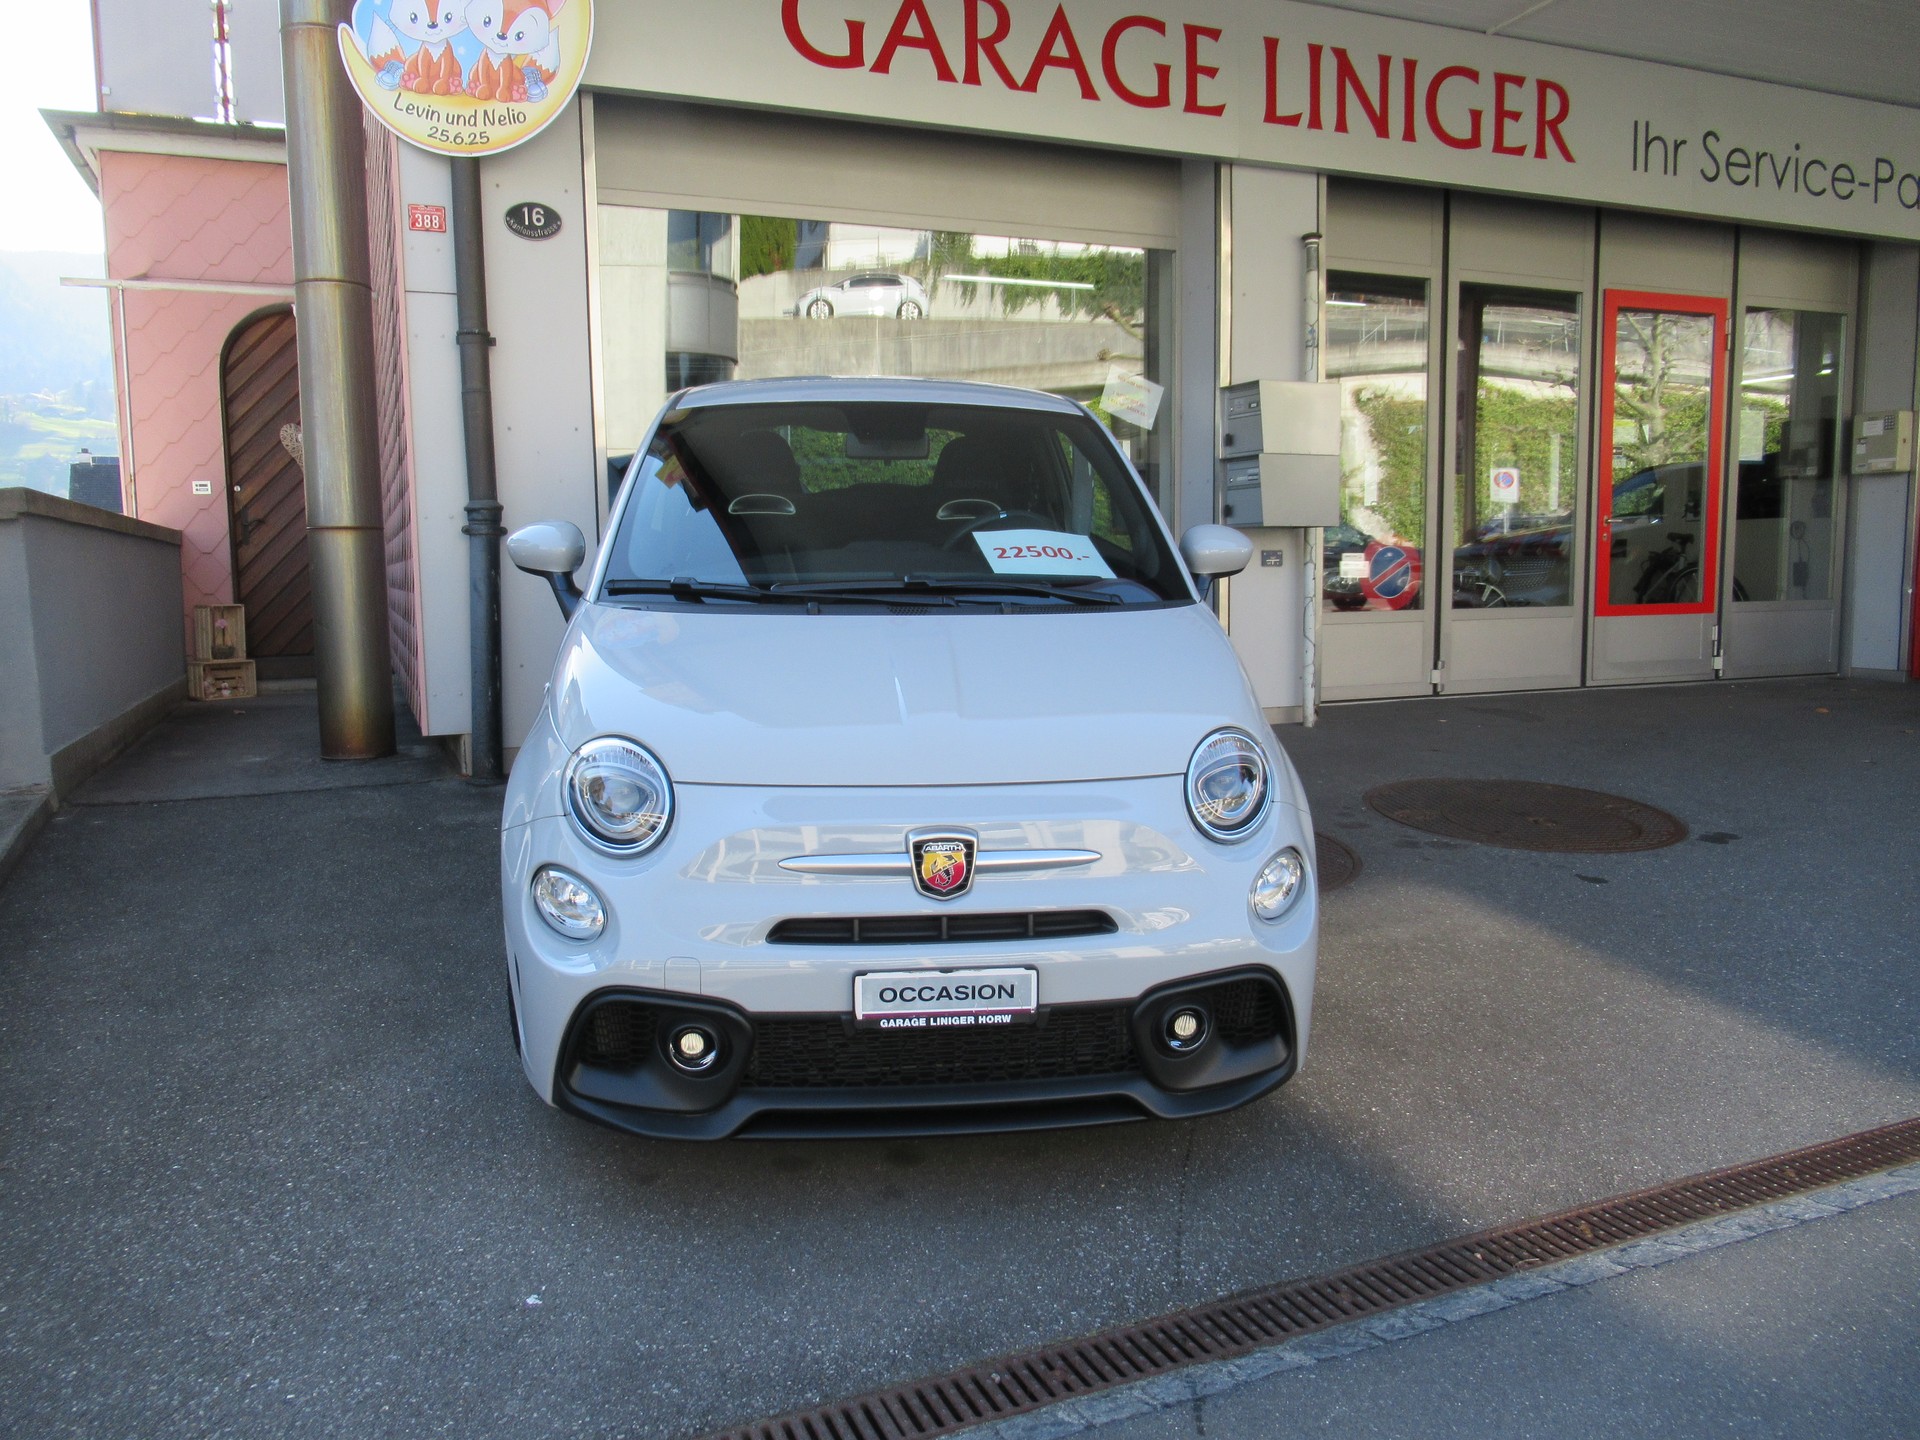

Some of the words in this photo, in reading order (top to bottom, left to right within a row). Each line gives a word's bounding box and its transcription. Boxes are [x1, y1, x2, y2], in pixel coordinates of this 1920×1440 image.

[780, 0, 1227, 117] GARAGE
[1262, 35, 1576, 164] LINIGER
[393, 92, 441, 123] Levin
[445, 109, 478, 128] und
[482, 106, 527, 127] Nelio
[426, 125, 490, 146] 25.6.25
[1632, 119, 1688, 177] Ihr
[415, 213, 440, 229] 388
[521, 206, 545, 226] 16
[993, 545, 1090, 561] 22500.-
[878, 984, 1015, 1003] OCCASION
[879, 1018, 927, 1028] GARAGE
[930, 1015, 975, 1026] LINIGER
[978, 1014, 1012, 1024] HORW
